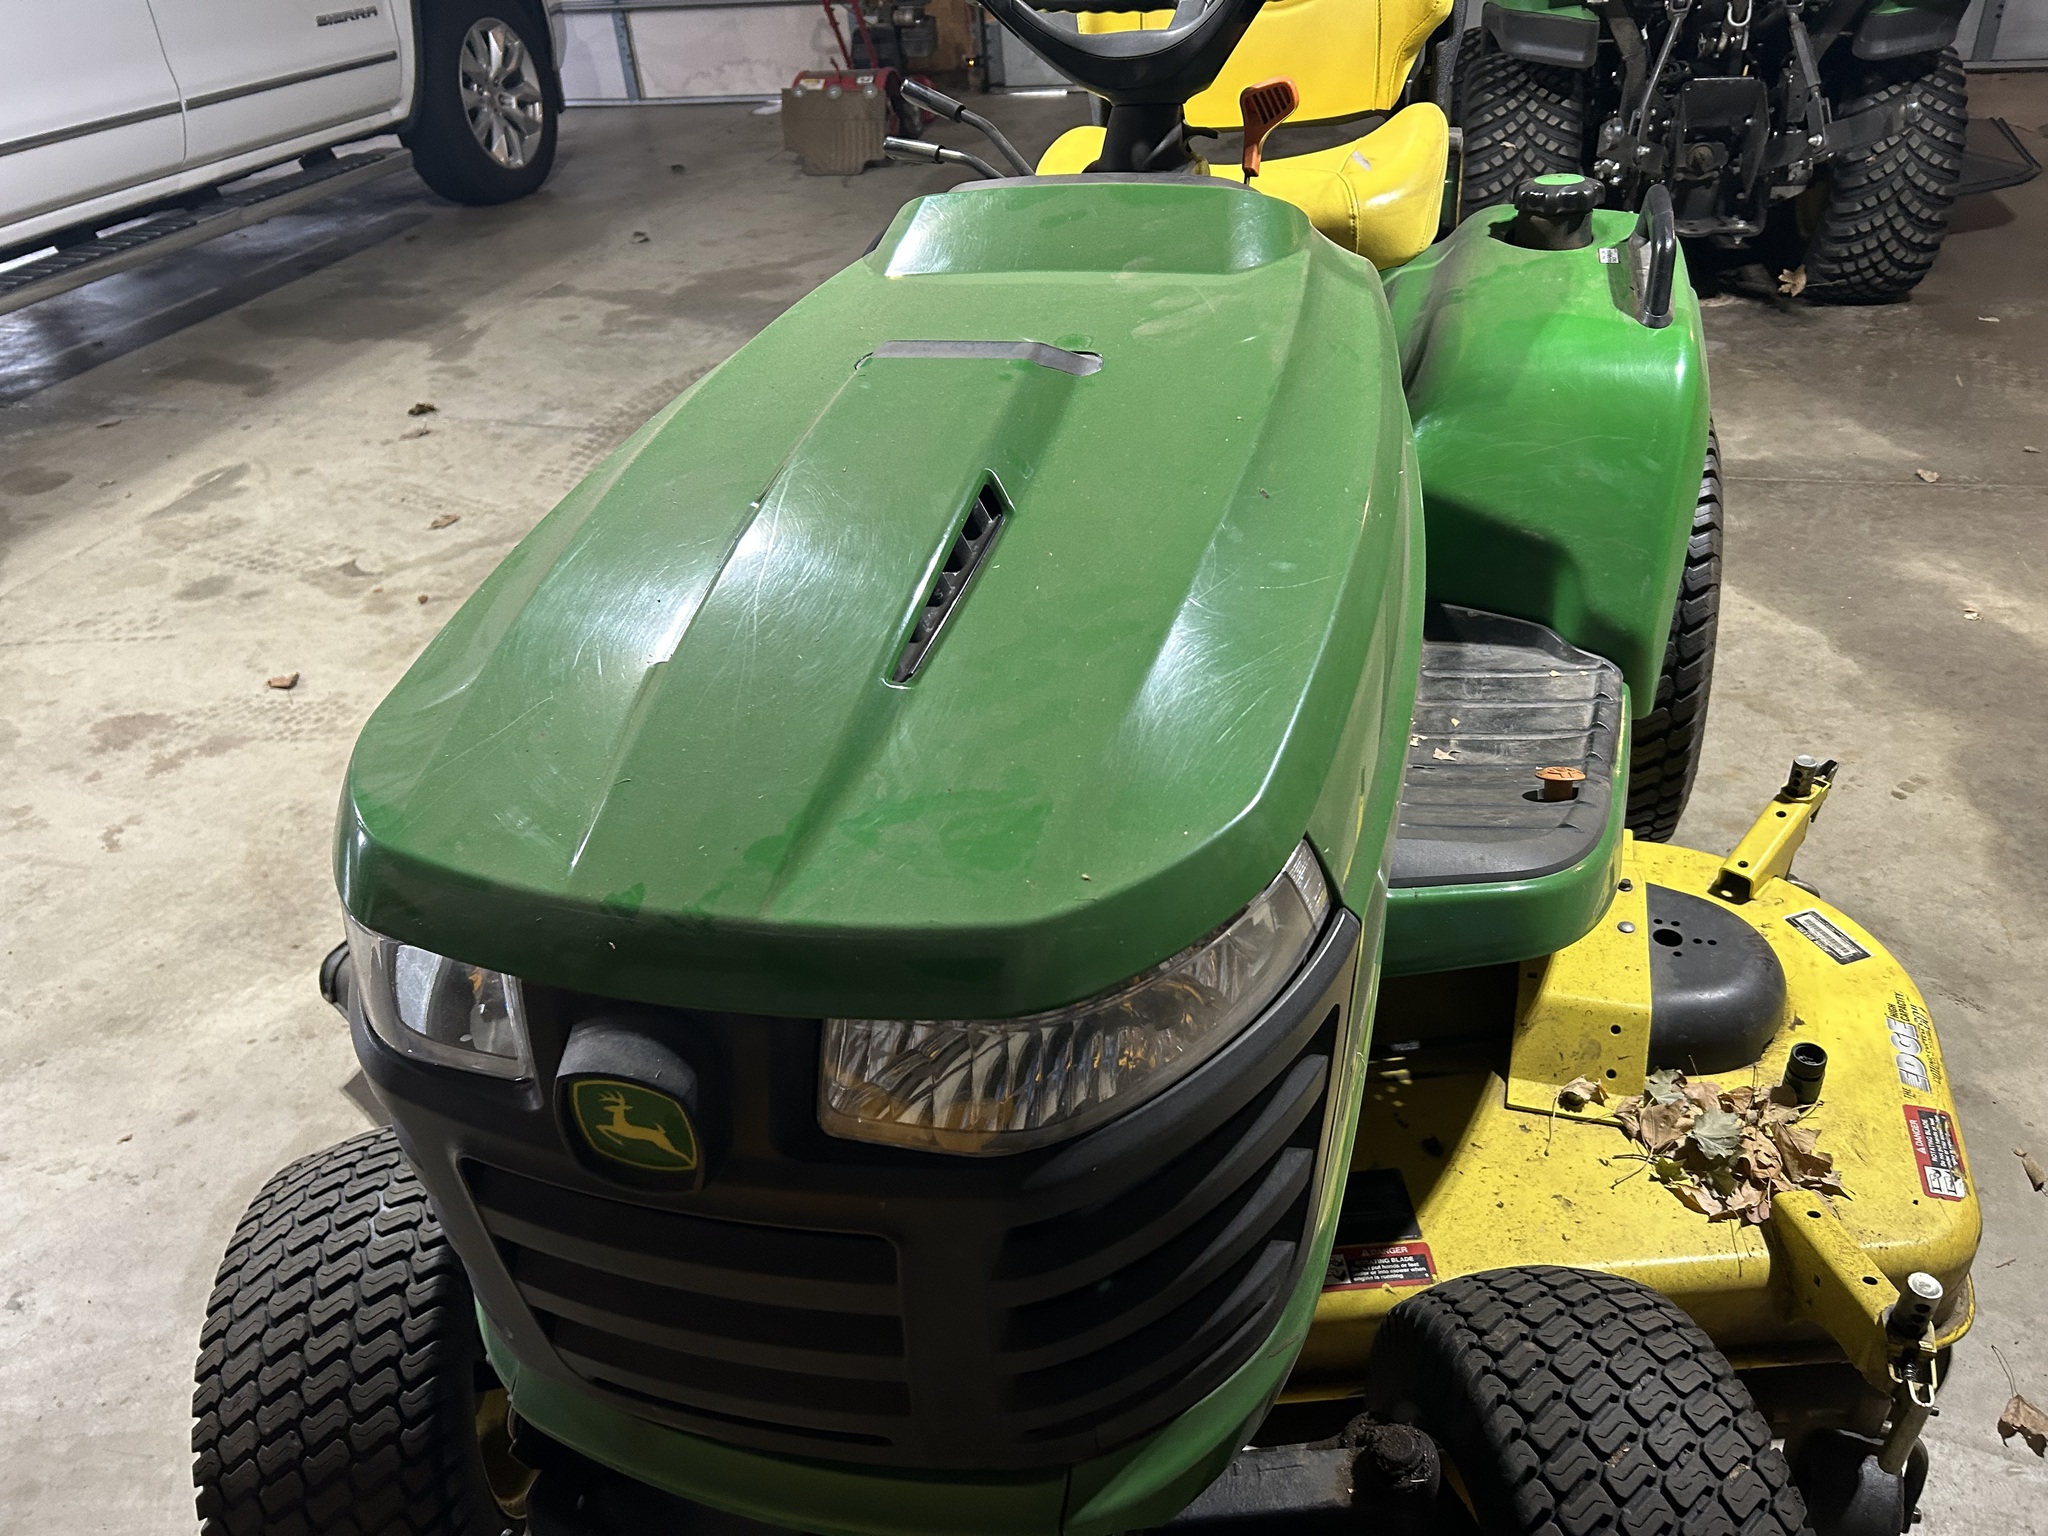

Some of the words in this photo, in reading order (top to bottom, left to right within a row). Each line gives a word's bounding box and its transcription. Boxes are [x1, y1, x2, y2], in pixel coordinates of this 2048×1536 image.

[316, 5, 378, 27] SIERRA
[1886, 1015, 1932, 1094] EDGE
[1909, 1119, 1924, 1147] DANGER
[1921, 1119, 1931, 1136] BLADE
[1926, 1135, 1938, 1162] ROTATING
[1370, 1246, 1408, 1256] DANGER
